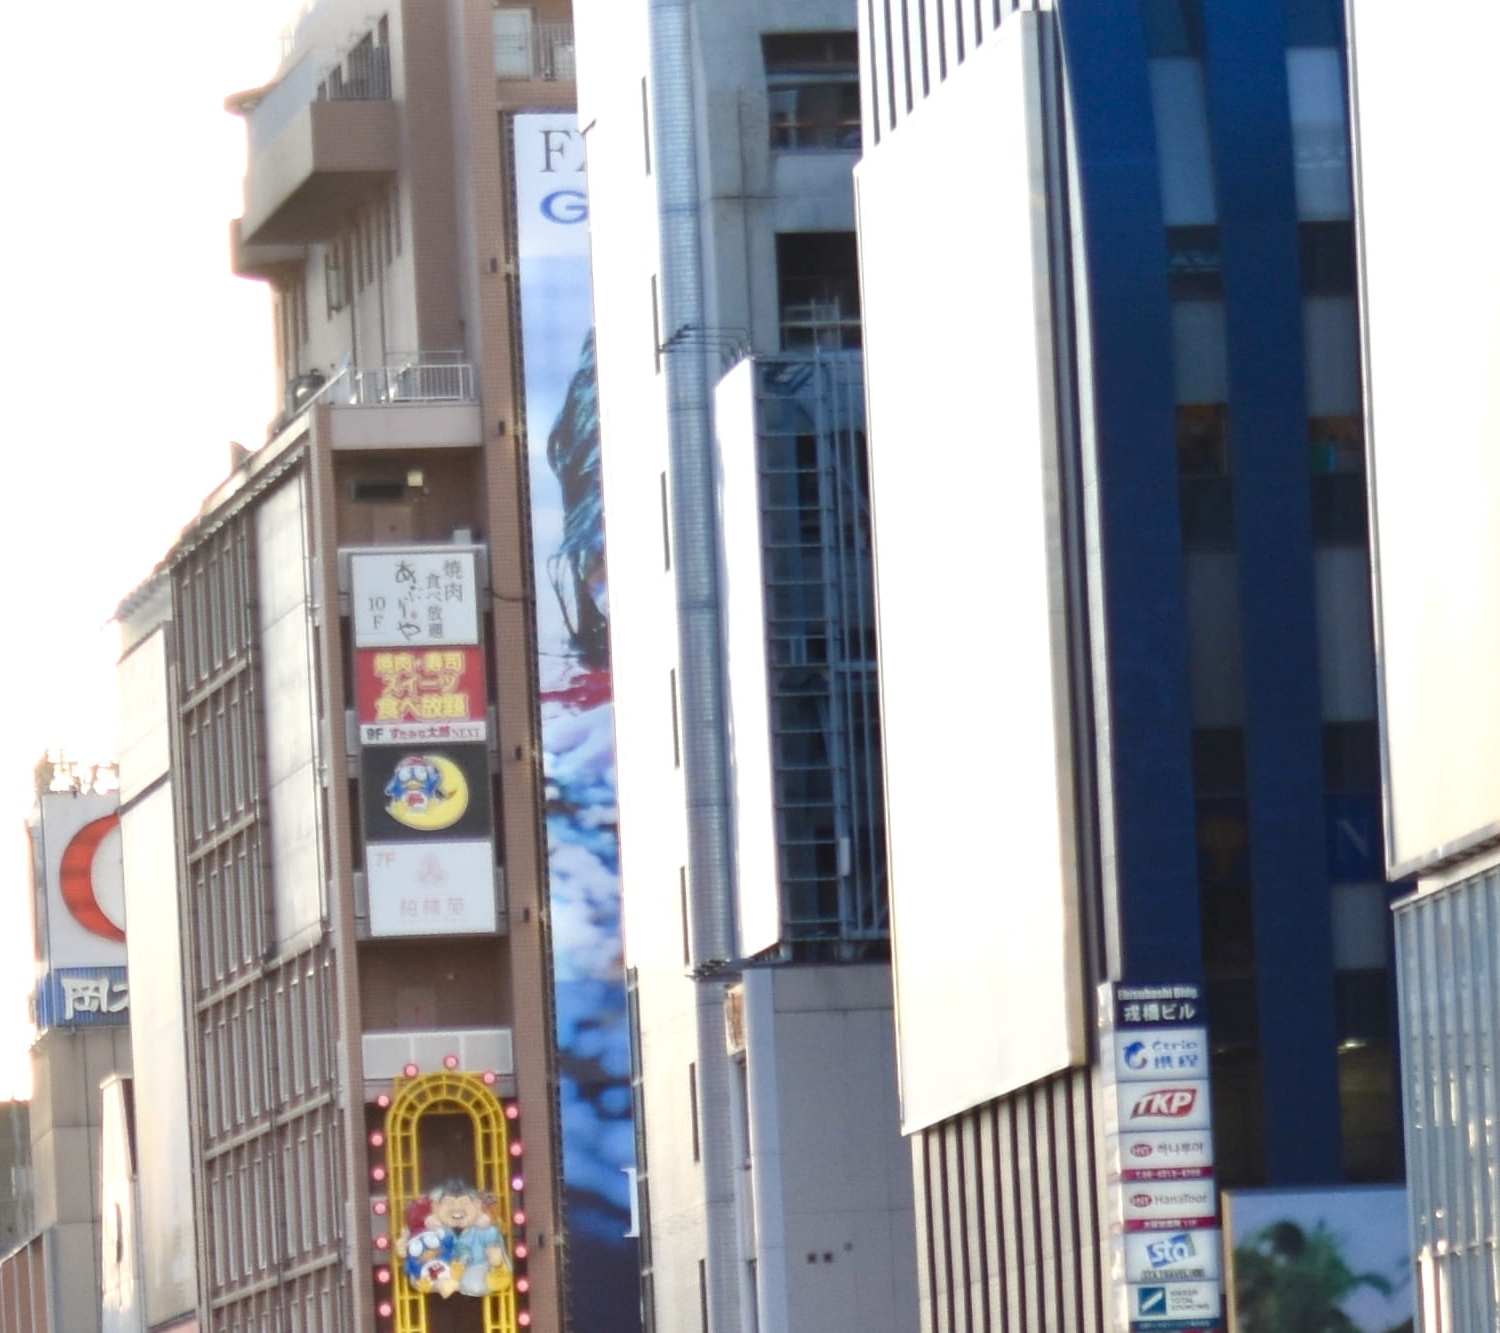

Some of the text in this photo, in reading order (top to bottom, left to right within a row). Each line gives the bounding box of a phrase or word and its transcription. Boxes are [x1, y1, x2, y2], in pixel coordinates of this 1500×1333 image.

[444, 559, 464, 603] 焼肉
[427, 573, 444, 639] 食べ放題
[384, 673, 460, 697] スイーツ
[375, 694, 468, 720] 食べ放題
[366, 727, 384, 741] 9F
[451, 727, 481, 739] NEXT
[376, 852, 396, 868] 7F
[1124, 1003, 1196, 1023] 戎橋ビル
[1137, 1091, 1193, 1116] TKP
[1155, 1194, 1208, 1206] HanaTour
